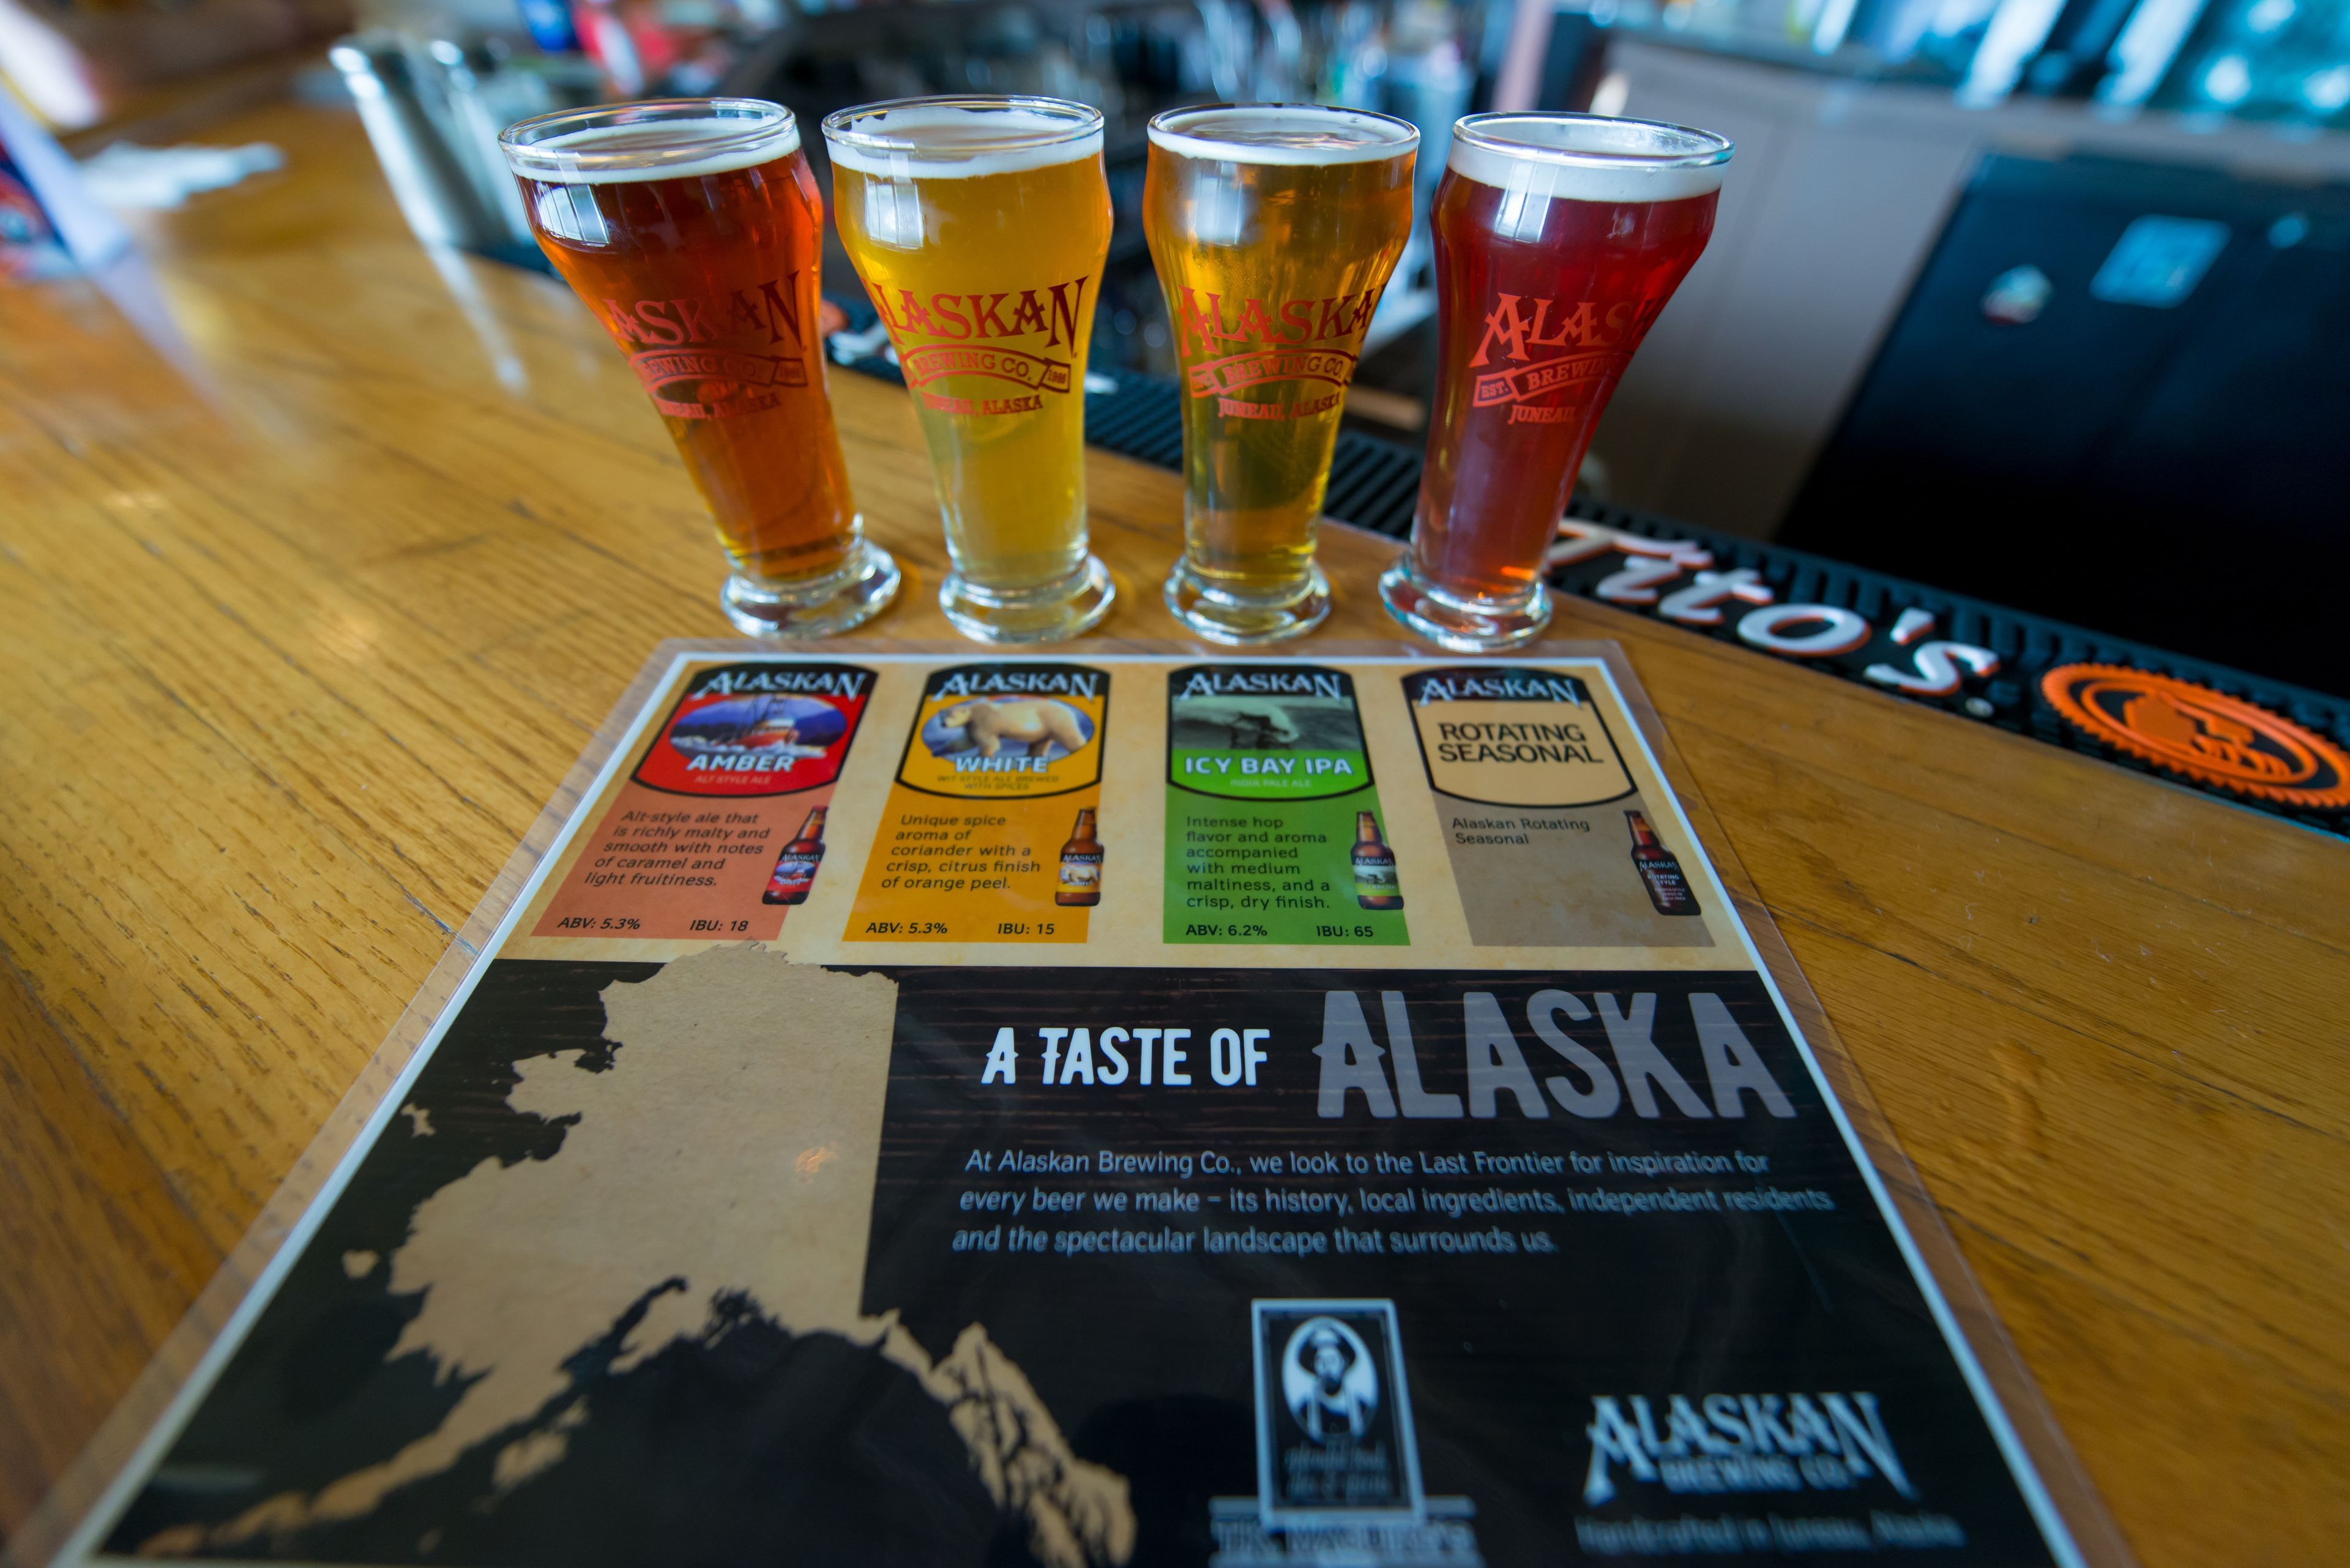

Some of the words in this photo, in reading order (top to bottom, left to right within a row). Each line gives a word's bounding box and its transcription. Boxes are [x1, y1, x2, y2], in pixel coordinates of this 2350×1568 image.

[860, 275, 1089, 358] LASKAN
[1178, 282, 1387, 358] ALASKA
[1001, 357, 1031, 381] CO.
[1222, 356, 1321, 385] BREWING
[1481, 381, 1509, 398] EST.
[982, 395, 1043, 415] ALASKA
[1218, 398, 1285, 421] JUNEAU,
[691, 671, 867, 702] ALASKAN
[931, 673, 1098, 703] ALASKAN
[1179, 673, 1343, 703] ALASKAN
[1417, 678, 1583, 709] ALASKAN
[1438, 722, 1587, 742] ROTATING
[1438, 744, 1604, 764] SEASONAL
[686, 754, 797, 772] AMBER
[955, 756, 1050, 773] WHITE
[1185, 757, 1233, 774] ICY
[1240, 757, 1297, 774] BAY
[1305, 758, 1354, 775] IPA
[695, 775, 715, 784] ALT
[716, 775, 749, 784] STYLE
[751, 775, 771, 784] ALE
[621, 811, 692, 826] Alt-style
[695, 812, 722, 824] ale
[725, 812, 759, 824] that
[900, 814, 960, 827] Unique
[963, 815, 1006, 827] spice
[1186, 816, 1248, 827] Intense
[1253, 816, 1283, 830] hop
[1452, 818, 1515, 831] Alaskan
[1521, 818, 1590, 832] Rotating
[613, 826, 629, 837] is
[632, 826, 681, 840] richly
[684, 826, 732, 840] malty
[733, 827, 770, 840] and
[895, 831, 948, 840] aroma
[953, 829, 972, 840] of
[1186, 831, 1231, 843] flavor
[1237, 832, 1269, 843] and
[1274, 834, 1327, 843] aroma
[1455, 834, 1529, 845] Seasonal
[603, 841, 672, 853] smooth
[674, 842, 711, 854] with
[717, 843, 764, 855] notes
[890, 845, 973, 856] coriander
[979, 846, 1015, 857] with
[1022, 848, 1031, 857] a
[1186, 846, 1298, 861] accompanied
[594, 856, 612, 868] of
[616, 857, 685, 869] caramel
[691, 858, 725, 870] and
[886, 861, 931, 875] crisp,
[939, 861, 987, 872] citrus
[993, 861, 1040, 873] finish
[1186, 862, 1225, 874] with
[1231, 863, 1301, 875] medium
[584, 872, 626, 887] light
[630, 873, 718, 887] fruitiness.
[881, 876, 901, 888] of
[904, 878, 965, 891] orange
[970, 877, 1012, 891] peel.
[1187, 879, 1276, 893] maltiness,
[1281, 879, 1315, 891] and
[1321, 883, 1330, 891] a
[1186, 895, 1234, 910] crisp,
[1240, 896, 1270, 911] dry
[1275, 896, 1330, 908] finish.
[557, 917, 597, 930] ABV:
[600, 919, 641, 930] 5.3%
[689, 920, 723, 931] IBU:
[730, 920, 748, 931] 18
[865, 922, 903, 934] ABV:
[908, 922, 948, 935] 5.3%
[998, 924, 1031, 935] IBU:
[1037, 924, 1055, 935] 15
[1185, 925, 1223, 936] ABV:
[1227, 925, 1268, 936] 6.2%
[1316, 925, 1349, 936] IBU:
[1354, 925, 1374, 937] 65
[981, 1028, 1018, 1085] A
[1039, 1028, 1192, 1086] TASTE
[1209, 1028, 1270, 1086] OF
[1311, 990, 1799, 1119] ALASKA
[965, 1149, 991, 1172] At
[998, 1149, 1089, 1173] Alaskan
[1099, 1151, 1192, 1178] Brewing
[1201, 1151, 1242, 1176] Co.,
[1252, 1156, 1283, 1173] we
[1291, 1151, 1340, 1173] look
[1347, 1154, 1369, 1173] to
[1376, 1151, 1412, 1174] the
[1419, 1151, 1469, 1174] Last
[1474, 1151, 1563, 1174] Frontier
[1569, 1151, 1602, 1174] for
[1608, 1151, 1735, 1178] inspiration
[1736, 1151, 1771, 1173] for
[960, 1190, 1026, 1215] every
[1032, 1187, 1085, 1211] beer
[1094, 1192, 1128, 1212] we
[1135, 1187, 1201, 1212] make
[1229, 1188, 1259, 1212] its
[1265, 1187, 1354, 1216] history,
[1360, 1187, 1415, 1212] local
[1421, 1187, 1565, 1218] ingredients,
[1567, 1186, 1721, 1216] independent
[1723, 1187, 1835, 1212] residents
[952, 1225, 1001, 1252] and
[1008, 1225, 1048, 1252] the
[1054, 1226, 1198, 1257] spectacular
[1204, 1226, 1327, 1258] landscape
[1336, 1227, 1384, 1253] that
[1390, 1226, 1517, 1253] surrounds
[1521, 1231, 1559, 1253] us.
[1583, 1392, 1921, 1507] ALASKAN
